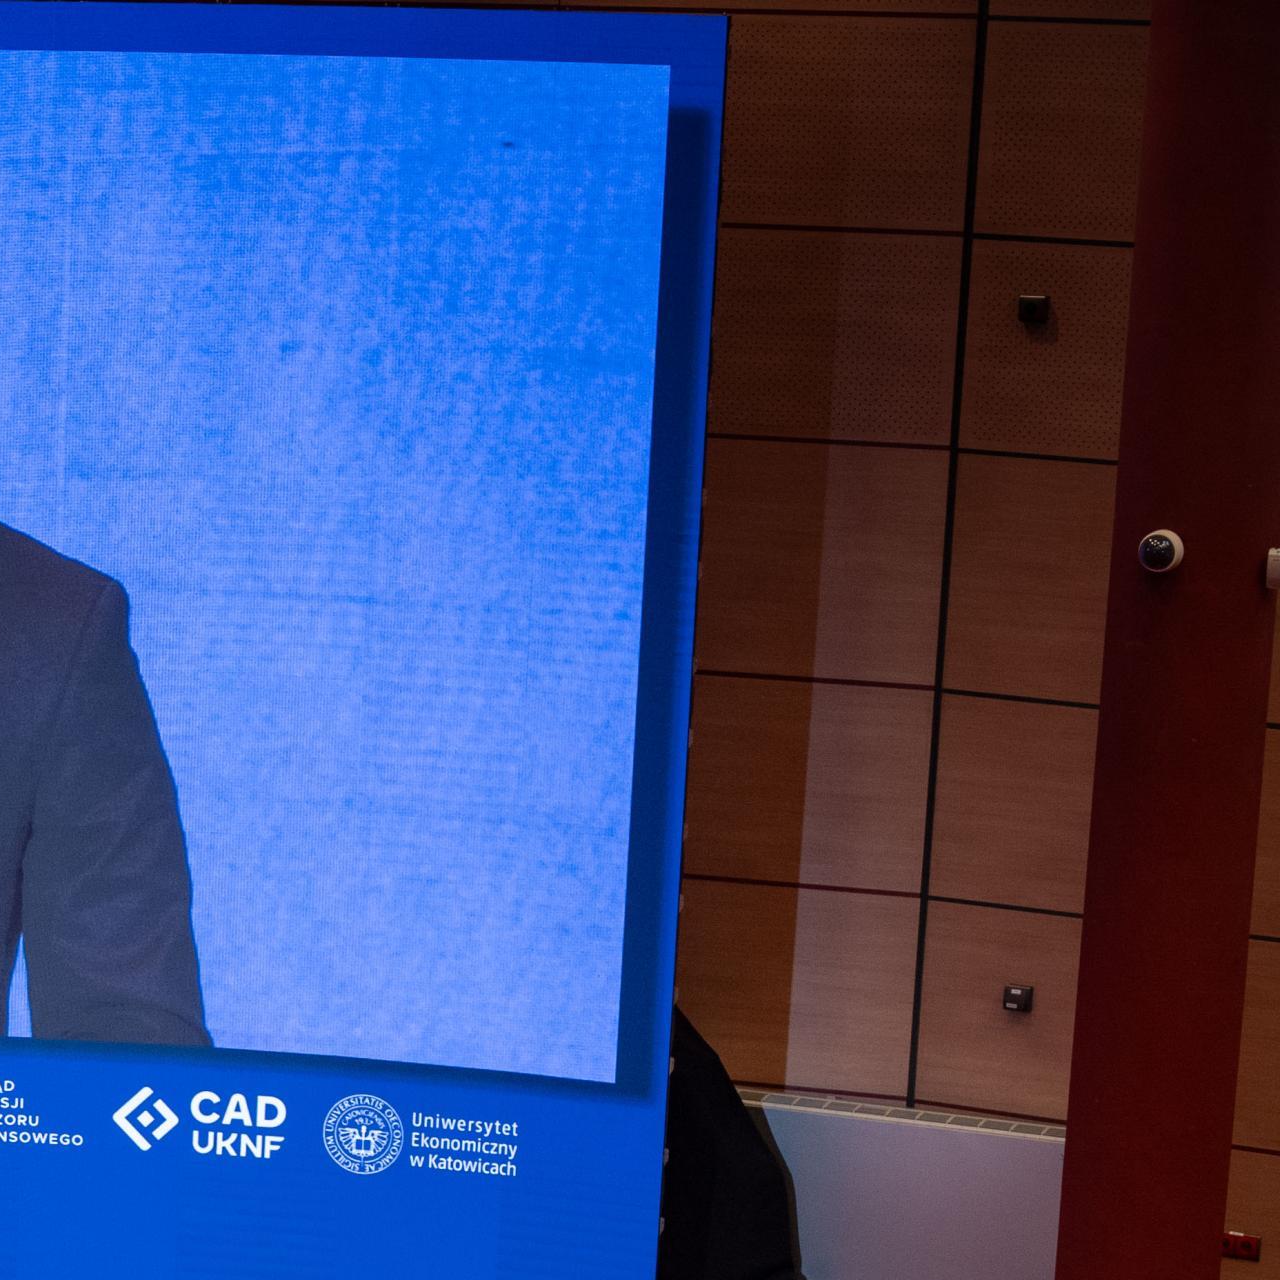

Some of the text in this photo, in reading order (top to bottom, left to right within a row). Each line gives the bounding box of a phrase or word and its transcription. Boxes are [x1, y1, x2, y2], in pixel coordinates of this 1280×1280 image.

[190, 1090, 287, 1128] CAD
[412, 1112, 518, 1137] Uniwersytet
[192, 1130, 285, 1159] UKNF
[411, 1131, 518, 1160] Ekonomiczny
[409, 1153, 517, 1177] w Katowicach
